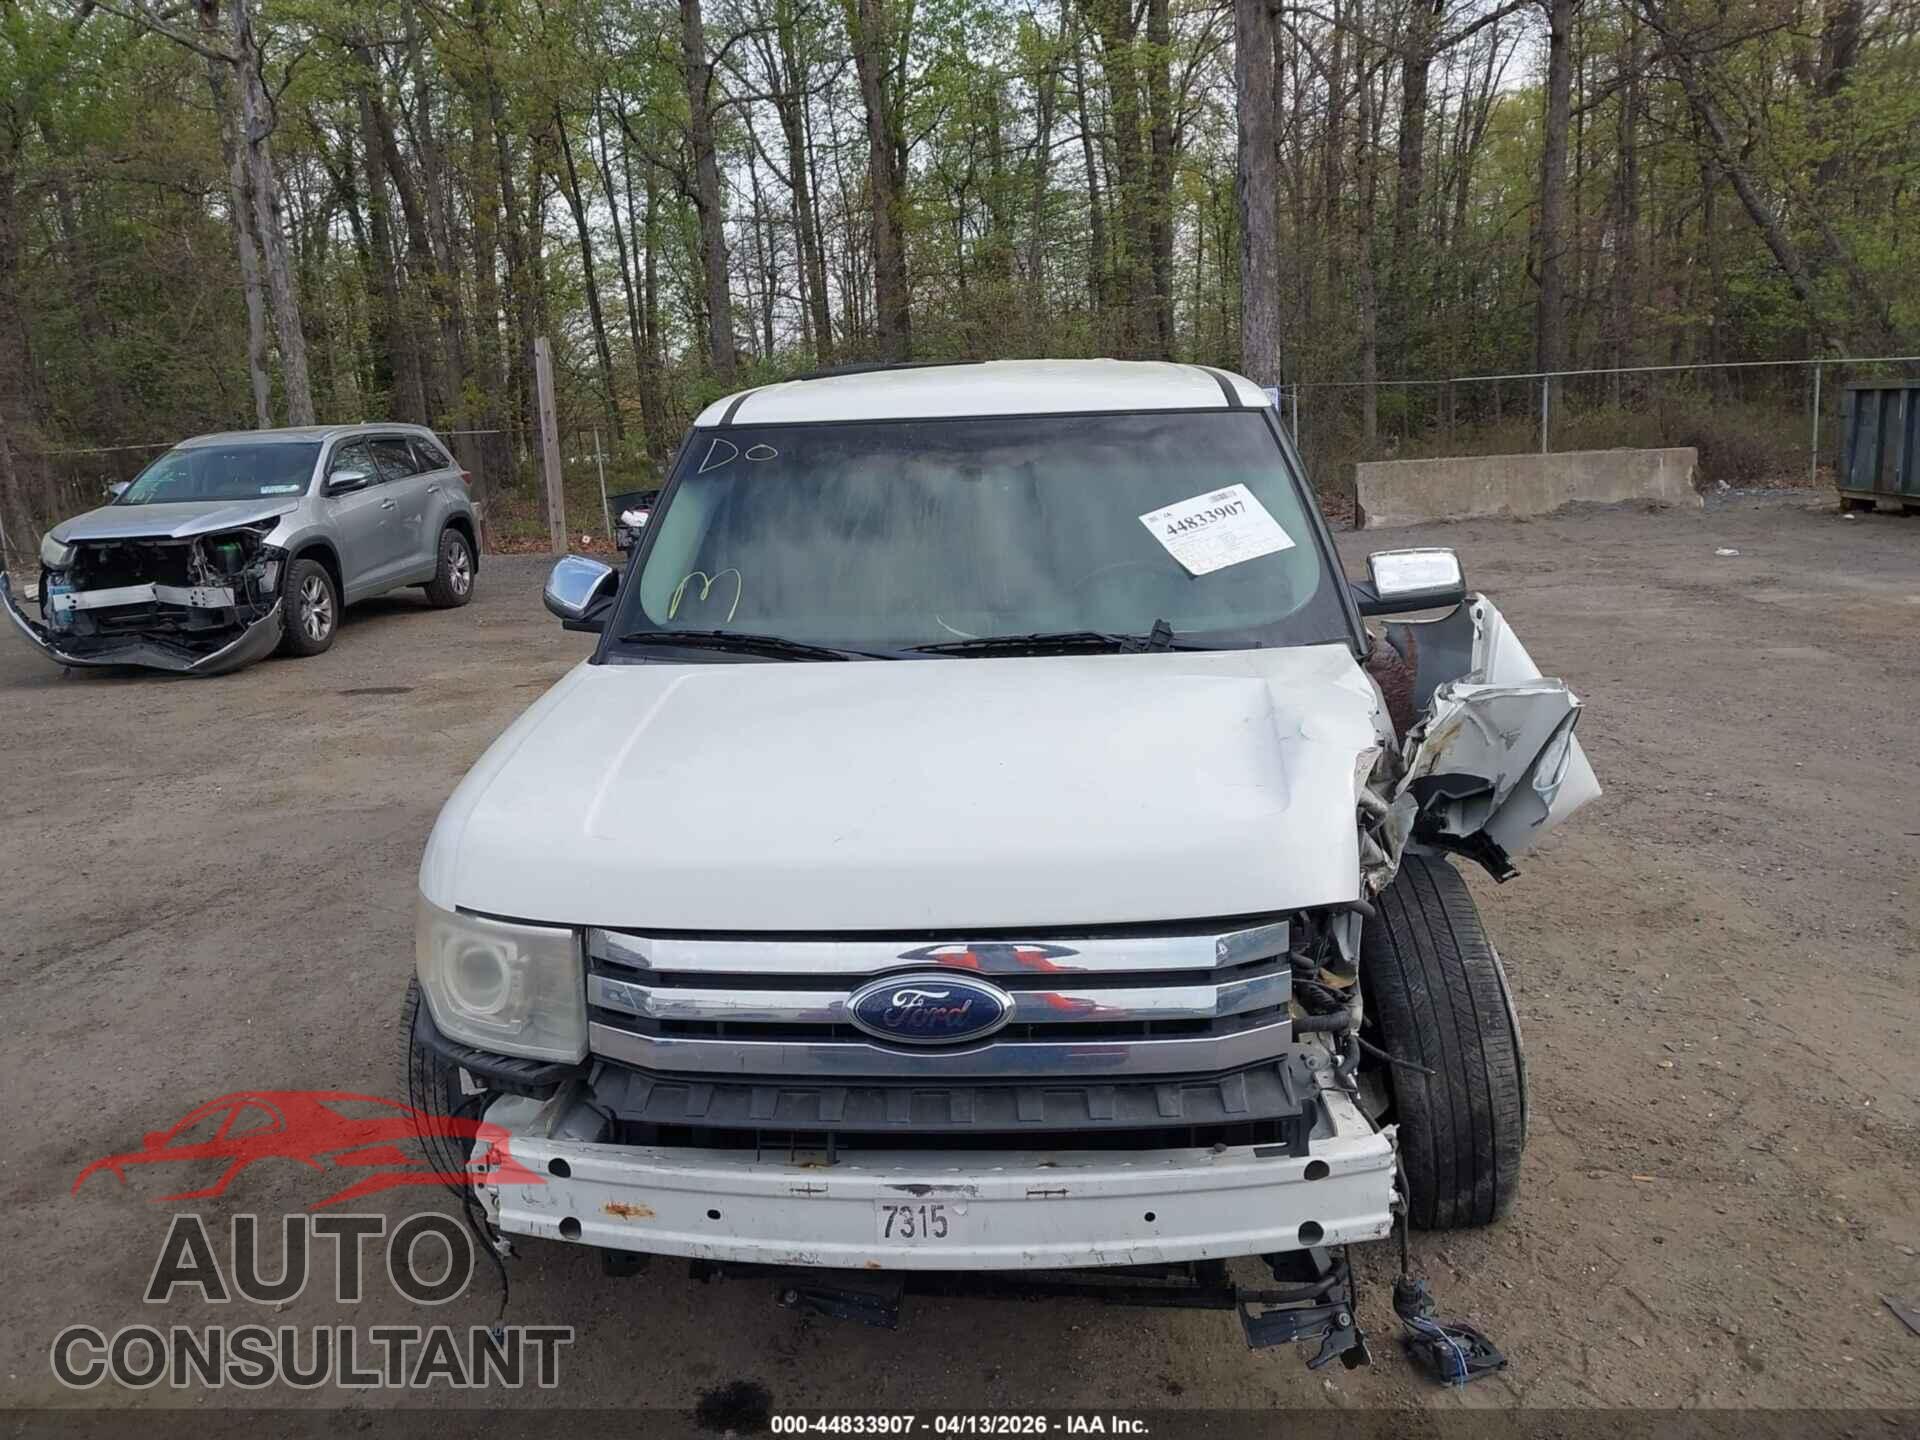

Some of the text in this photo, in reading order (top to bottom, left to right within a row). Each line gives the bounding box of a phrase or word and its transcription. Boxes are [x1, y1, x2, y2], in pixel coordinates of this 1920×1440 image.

[1166, 500, 1247, 536] 44833907
[883, 988, 972, 1028] Ford
[882, 1204, 948, 1239] 7315
